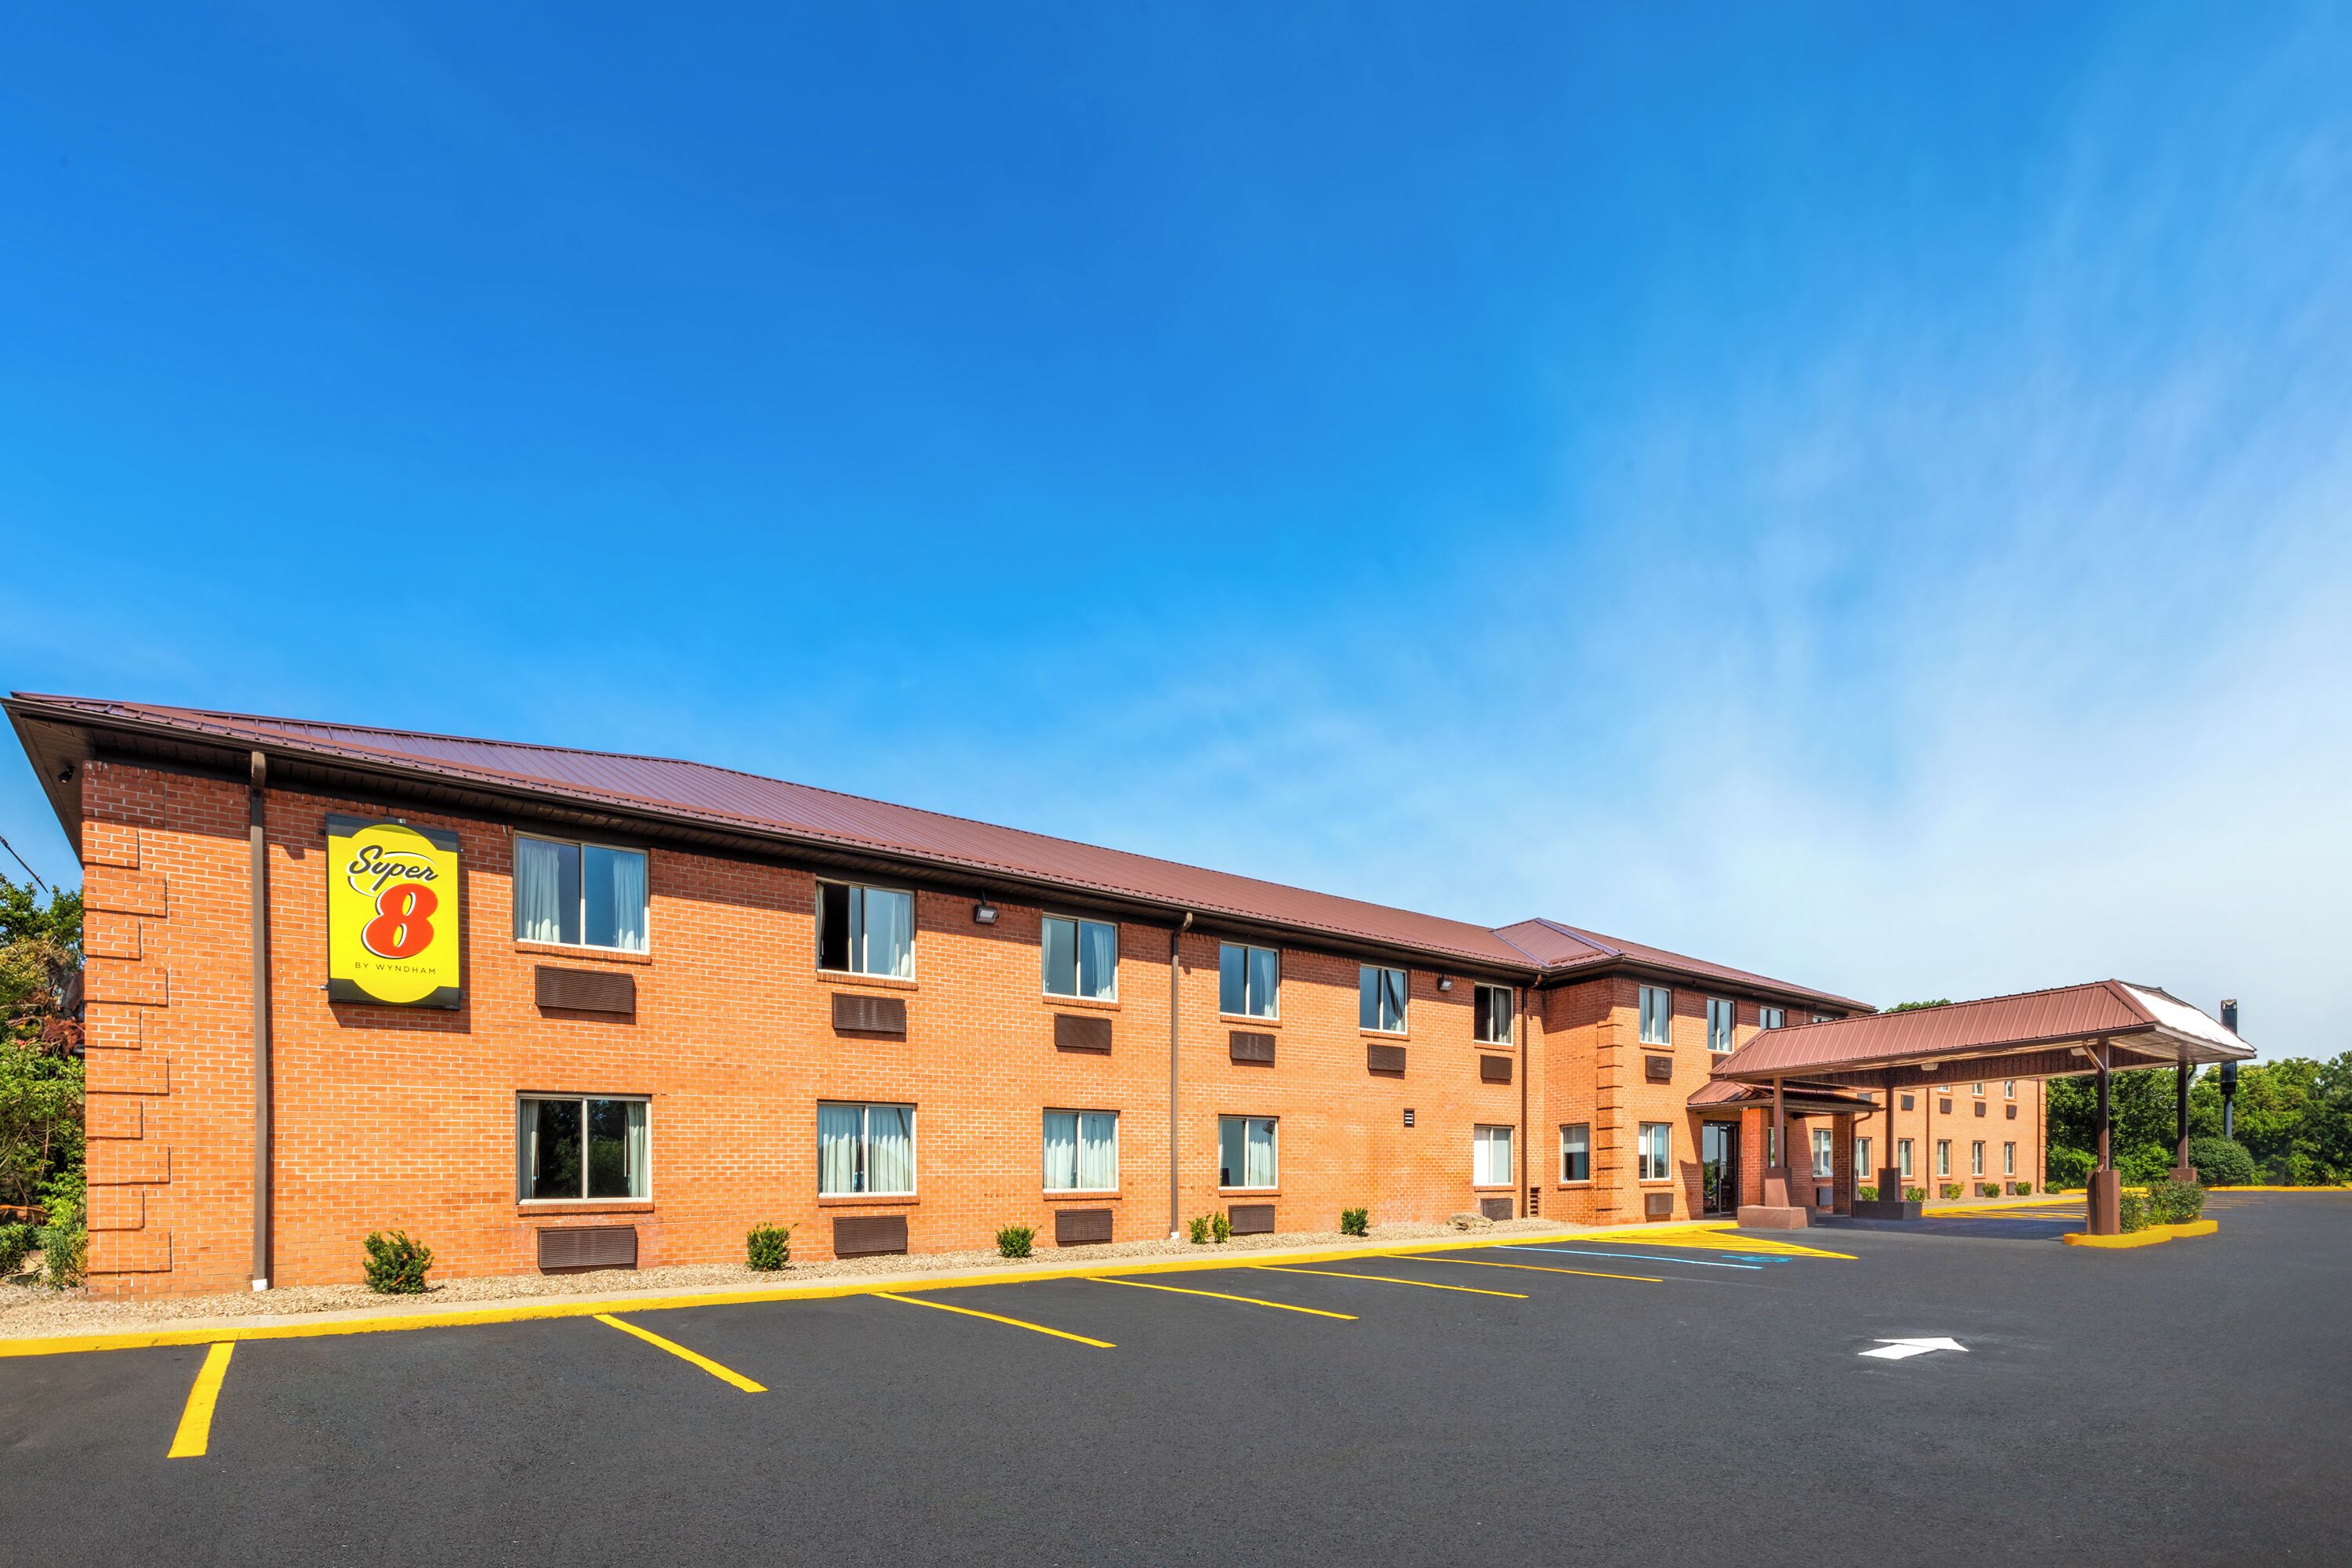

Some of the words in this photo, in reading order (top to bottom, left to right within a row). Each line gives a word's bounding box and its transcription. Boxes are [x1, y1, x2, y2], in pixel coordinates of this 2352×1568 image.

[347, 845, 438, 891] Super
[361, 883, 438, 960] 8
[376, 964, 436, 975] WYNDHAM
